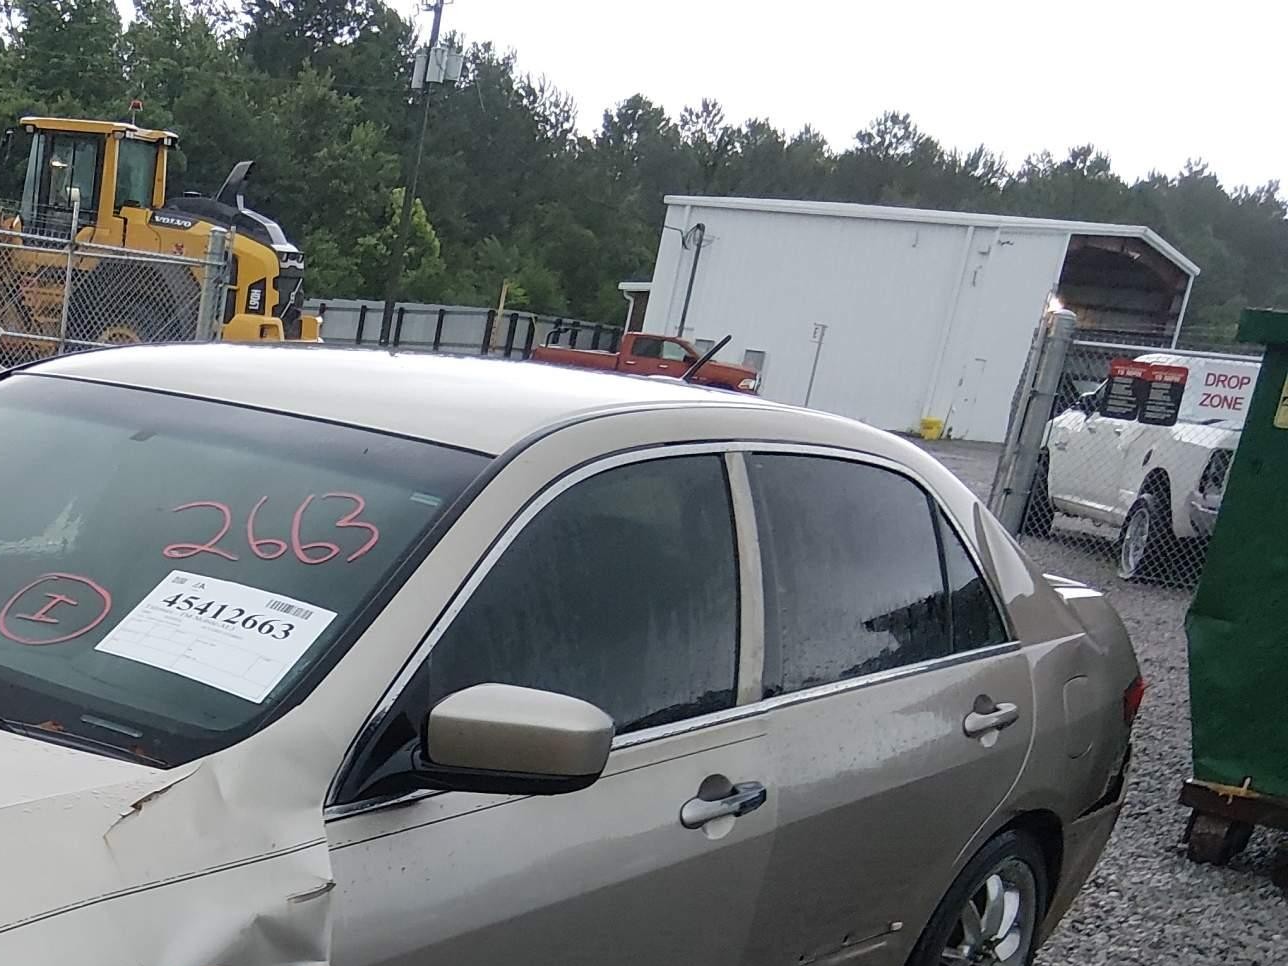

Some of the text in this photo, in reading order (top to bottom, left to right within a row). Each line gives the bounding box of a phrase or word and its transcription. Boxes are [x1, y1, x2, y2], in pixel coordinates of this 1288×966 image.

[154, 215, 192, 228] VOLVO
[248, 289, 262, 310] L90H
[1204, 372, 1252, 391] DROP
[1199, 392, 1245, 411] ZONE
[163, 492, 380, 565] 2663
[160, 592, 296, 641] 45412663
